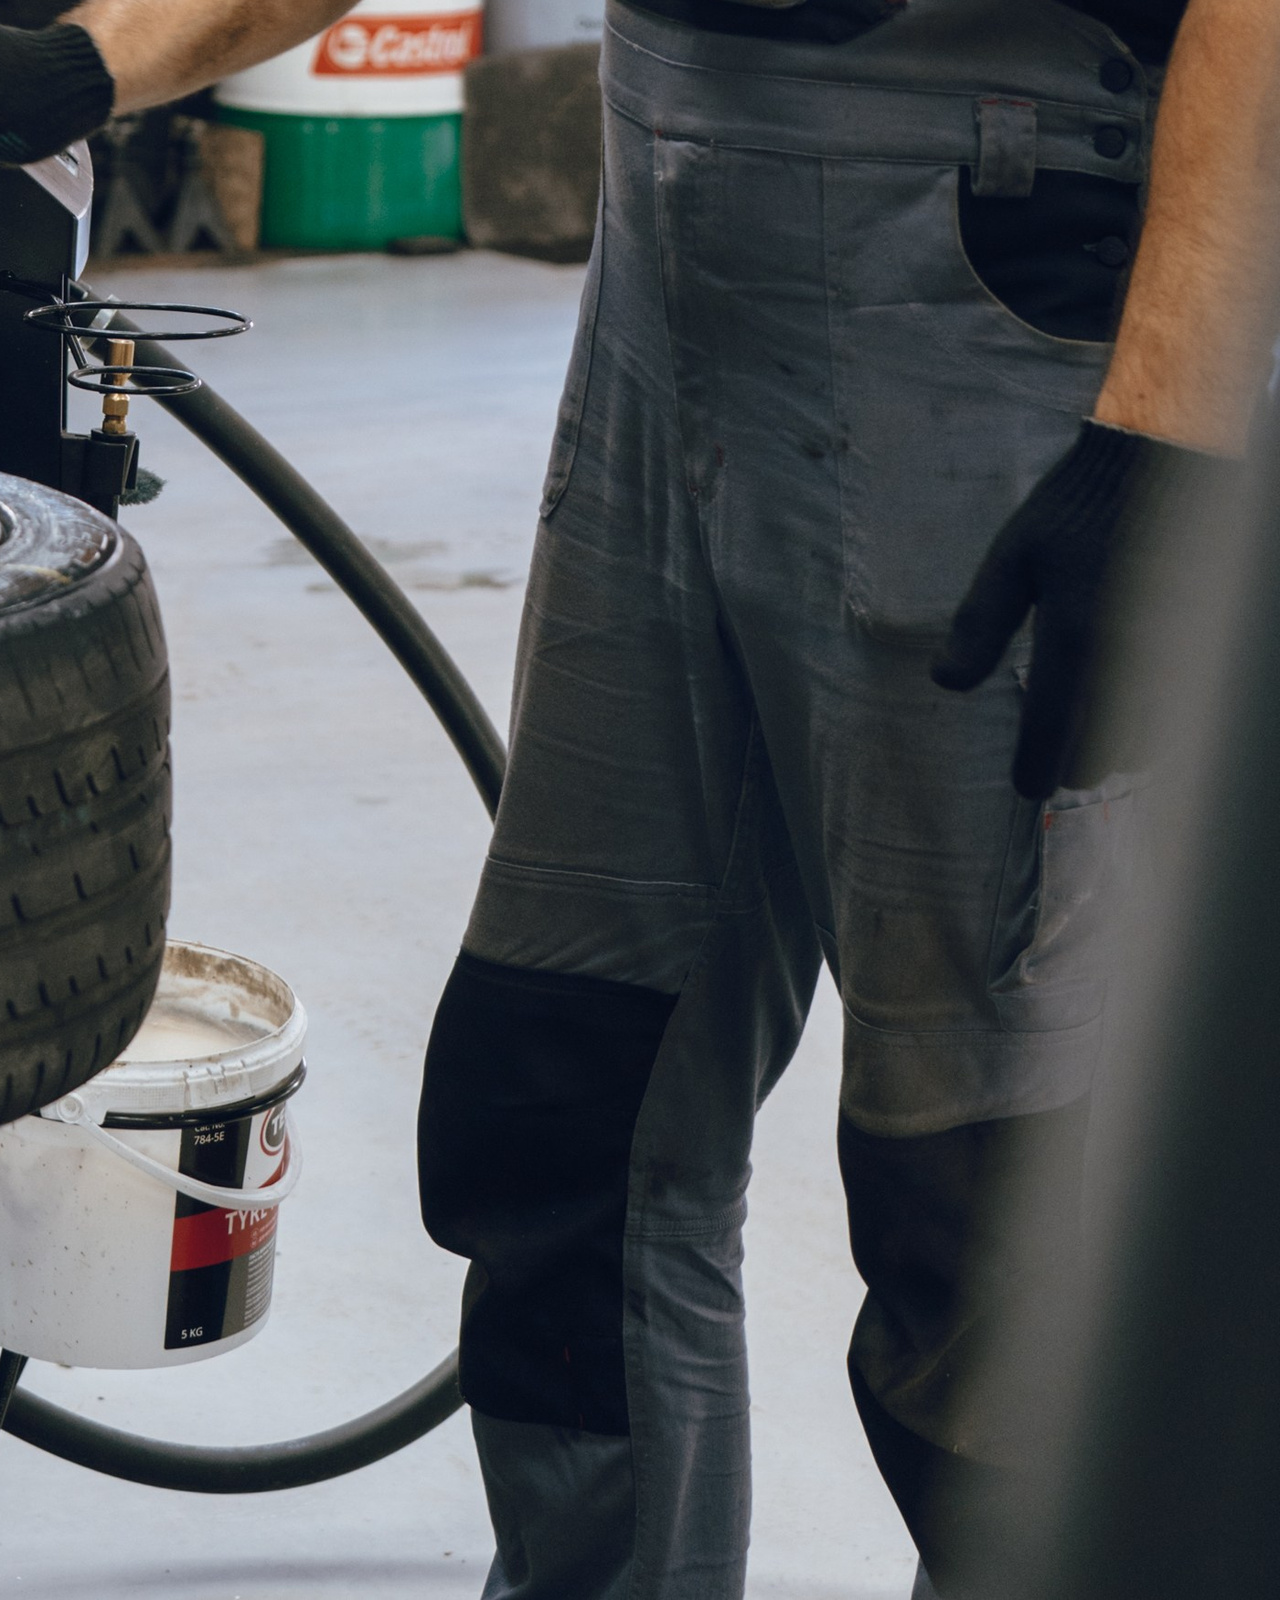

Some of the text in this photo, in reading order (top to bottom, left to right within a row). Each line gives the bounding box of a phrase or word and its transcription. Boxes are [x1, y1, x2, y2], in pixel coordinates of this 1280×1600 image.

[370, 22, 472, 68] Castrol
[194, 1131, 225, 1145] 784-5E
[181, 1326, 203, 1340] 5 KG
